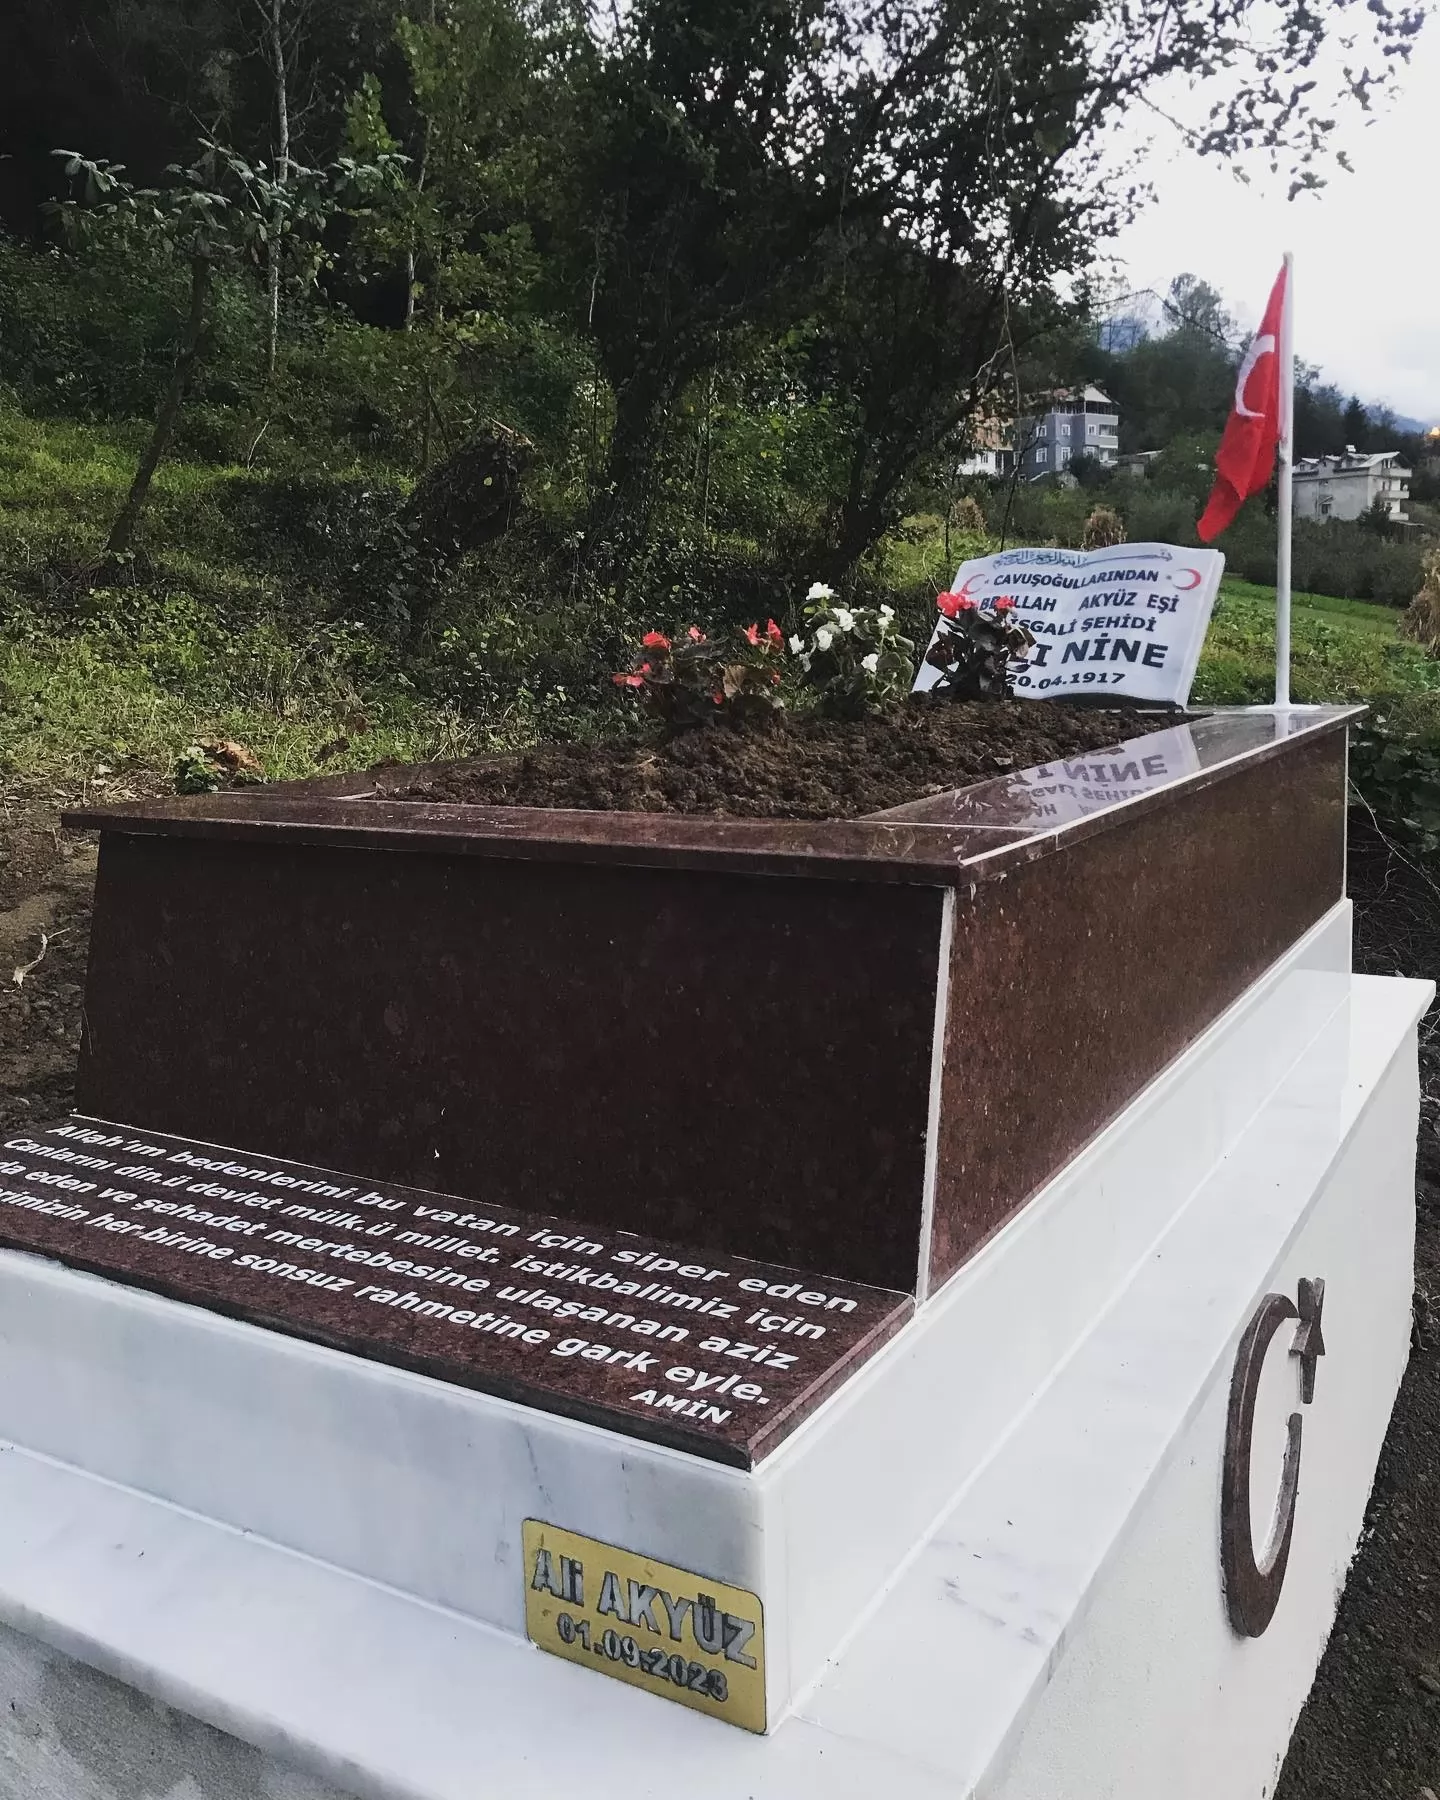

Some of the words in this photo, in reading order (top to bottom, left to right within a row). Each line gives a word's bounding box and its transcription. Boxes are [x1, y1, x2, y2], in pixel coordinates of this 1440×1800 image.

[1078, 588, 1138, 611] AKYÜZ
[1147, 594, 1180, 614] EŞİ
[1081, 613, 1157, 632] ŞEHİDİ
[1005, 671, 1126, 690] 20.04.1917
[1061, 632, 1169, 668] NİNE
[3, 1138, 117, 1170] Canlarını
[186, 1182, 283, 1210] devlet
[393, 1230, 499, 1263] millet.
[510, 1255, 740, 1319] istikbalimiz
[745, 1308, 827, 1340] için
[25, 1171, 98, 1193] eden
[98, 1187, 138, 1203] ve
[131, 1199, 267, 1236] şehadet
[263, 1230, 491, 1292] mertebesine
[496, 1286, 690, 1343] ulaşanan
[698, 1335, 800, 1370] aziz
[167, 1151, 358, 1199] bedenlerini
[354, 1191, 407, 1211] bu
[413, 1205, 521, 1237] vatan
[527, 1228, 604, 1256] için
[610, 1250, 730, 1282] siper
[738, 1278, 858, 1314] eden
[0, 1188, 90, 1220] rimizin
[85, 1213, 146, 1234] her
[139, 1227, 234, 1260] birine
[232, 1254, 356, 1292] sonsuz
[353, 1285, 551, 1344] rahmetine
[550, 1338, 660, 1373] gark
[664, 1366, 770, 1405] eyle.
[629, 1389, 732, 1424] AMİN
[531, 1548, 585, 1608] Ali
[597, 1570, 757, 1670] AKYÜZ
